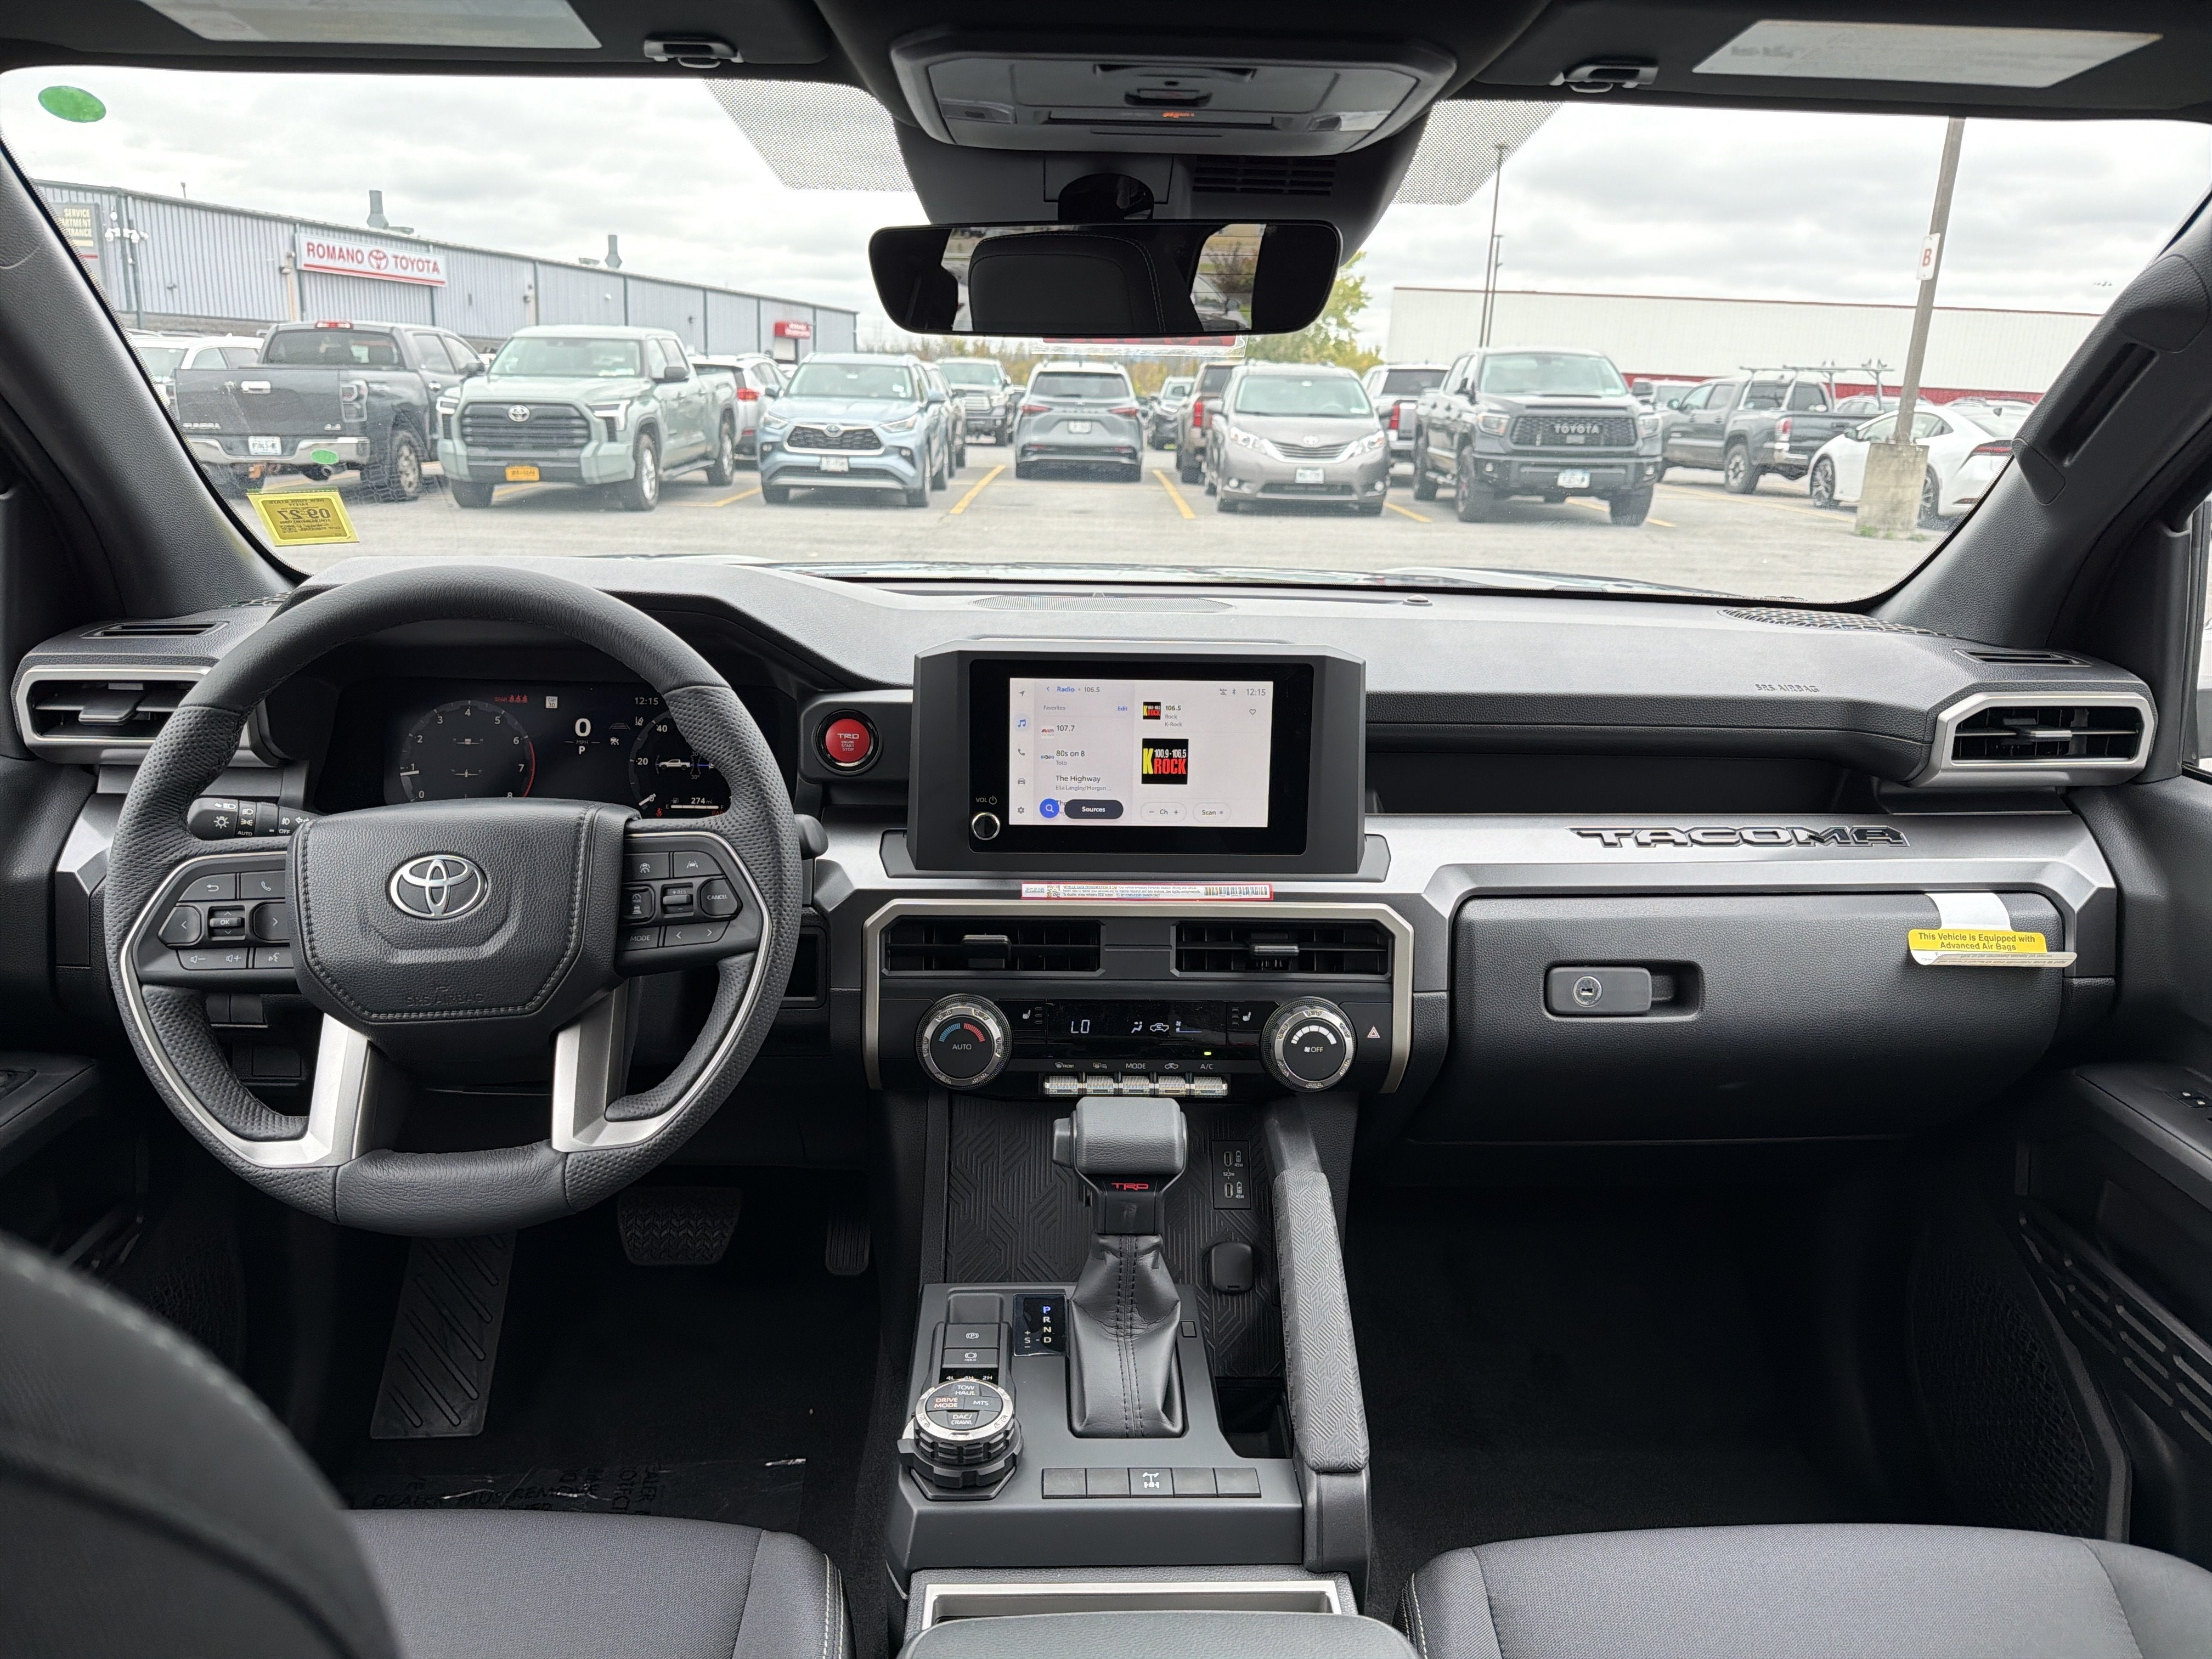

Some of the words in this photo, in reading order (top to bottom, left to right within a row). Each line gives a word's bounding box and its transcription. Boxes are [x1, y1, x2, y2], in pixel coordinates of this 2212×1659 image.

[64, 208, 90, 218] SERVICE
[306, 241, 364, 264] ROMANO
[392, 255, 440, 274] TOYOTA
[1922, 248, 1932, 267] B
[1554, 423, 1599, 433] TOYOTA
[1778, 684, 1820, 692] AIRBAG
[575, 718, 591, 737] 0
[578, 746, 585, 754] P
[1070, 775, 1101, 783] Highway
[419, 790, 424, 798] 0
[1566, 826, 1911, 848] TACOMA
[1938, 933, 1967, 941] Vehicle
[1978, 934, 2016, 944] Equipped
[1940, 941, 1980, 950] Advanced
[1996, 943, 2016, 951] Bags
